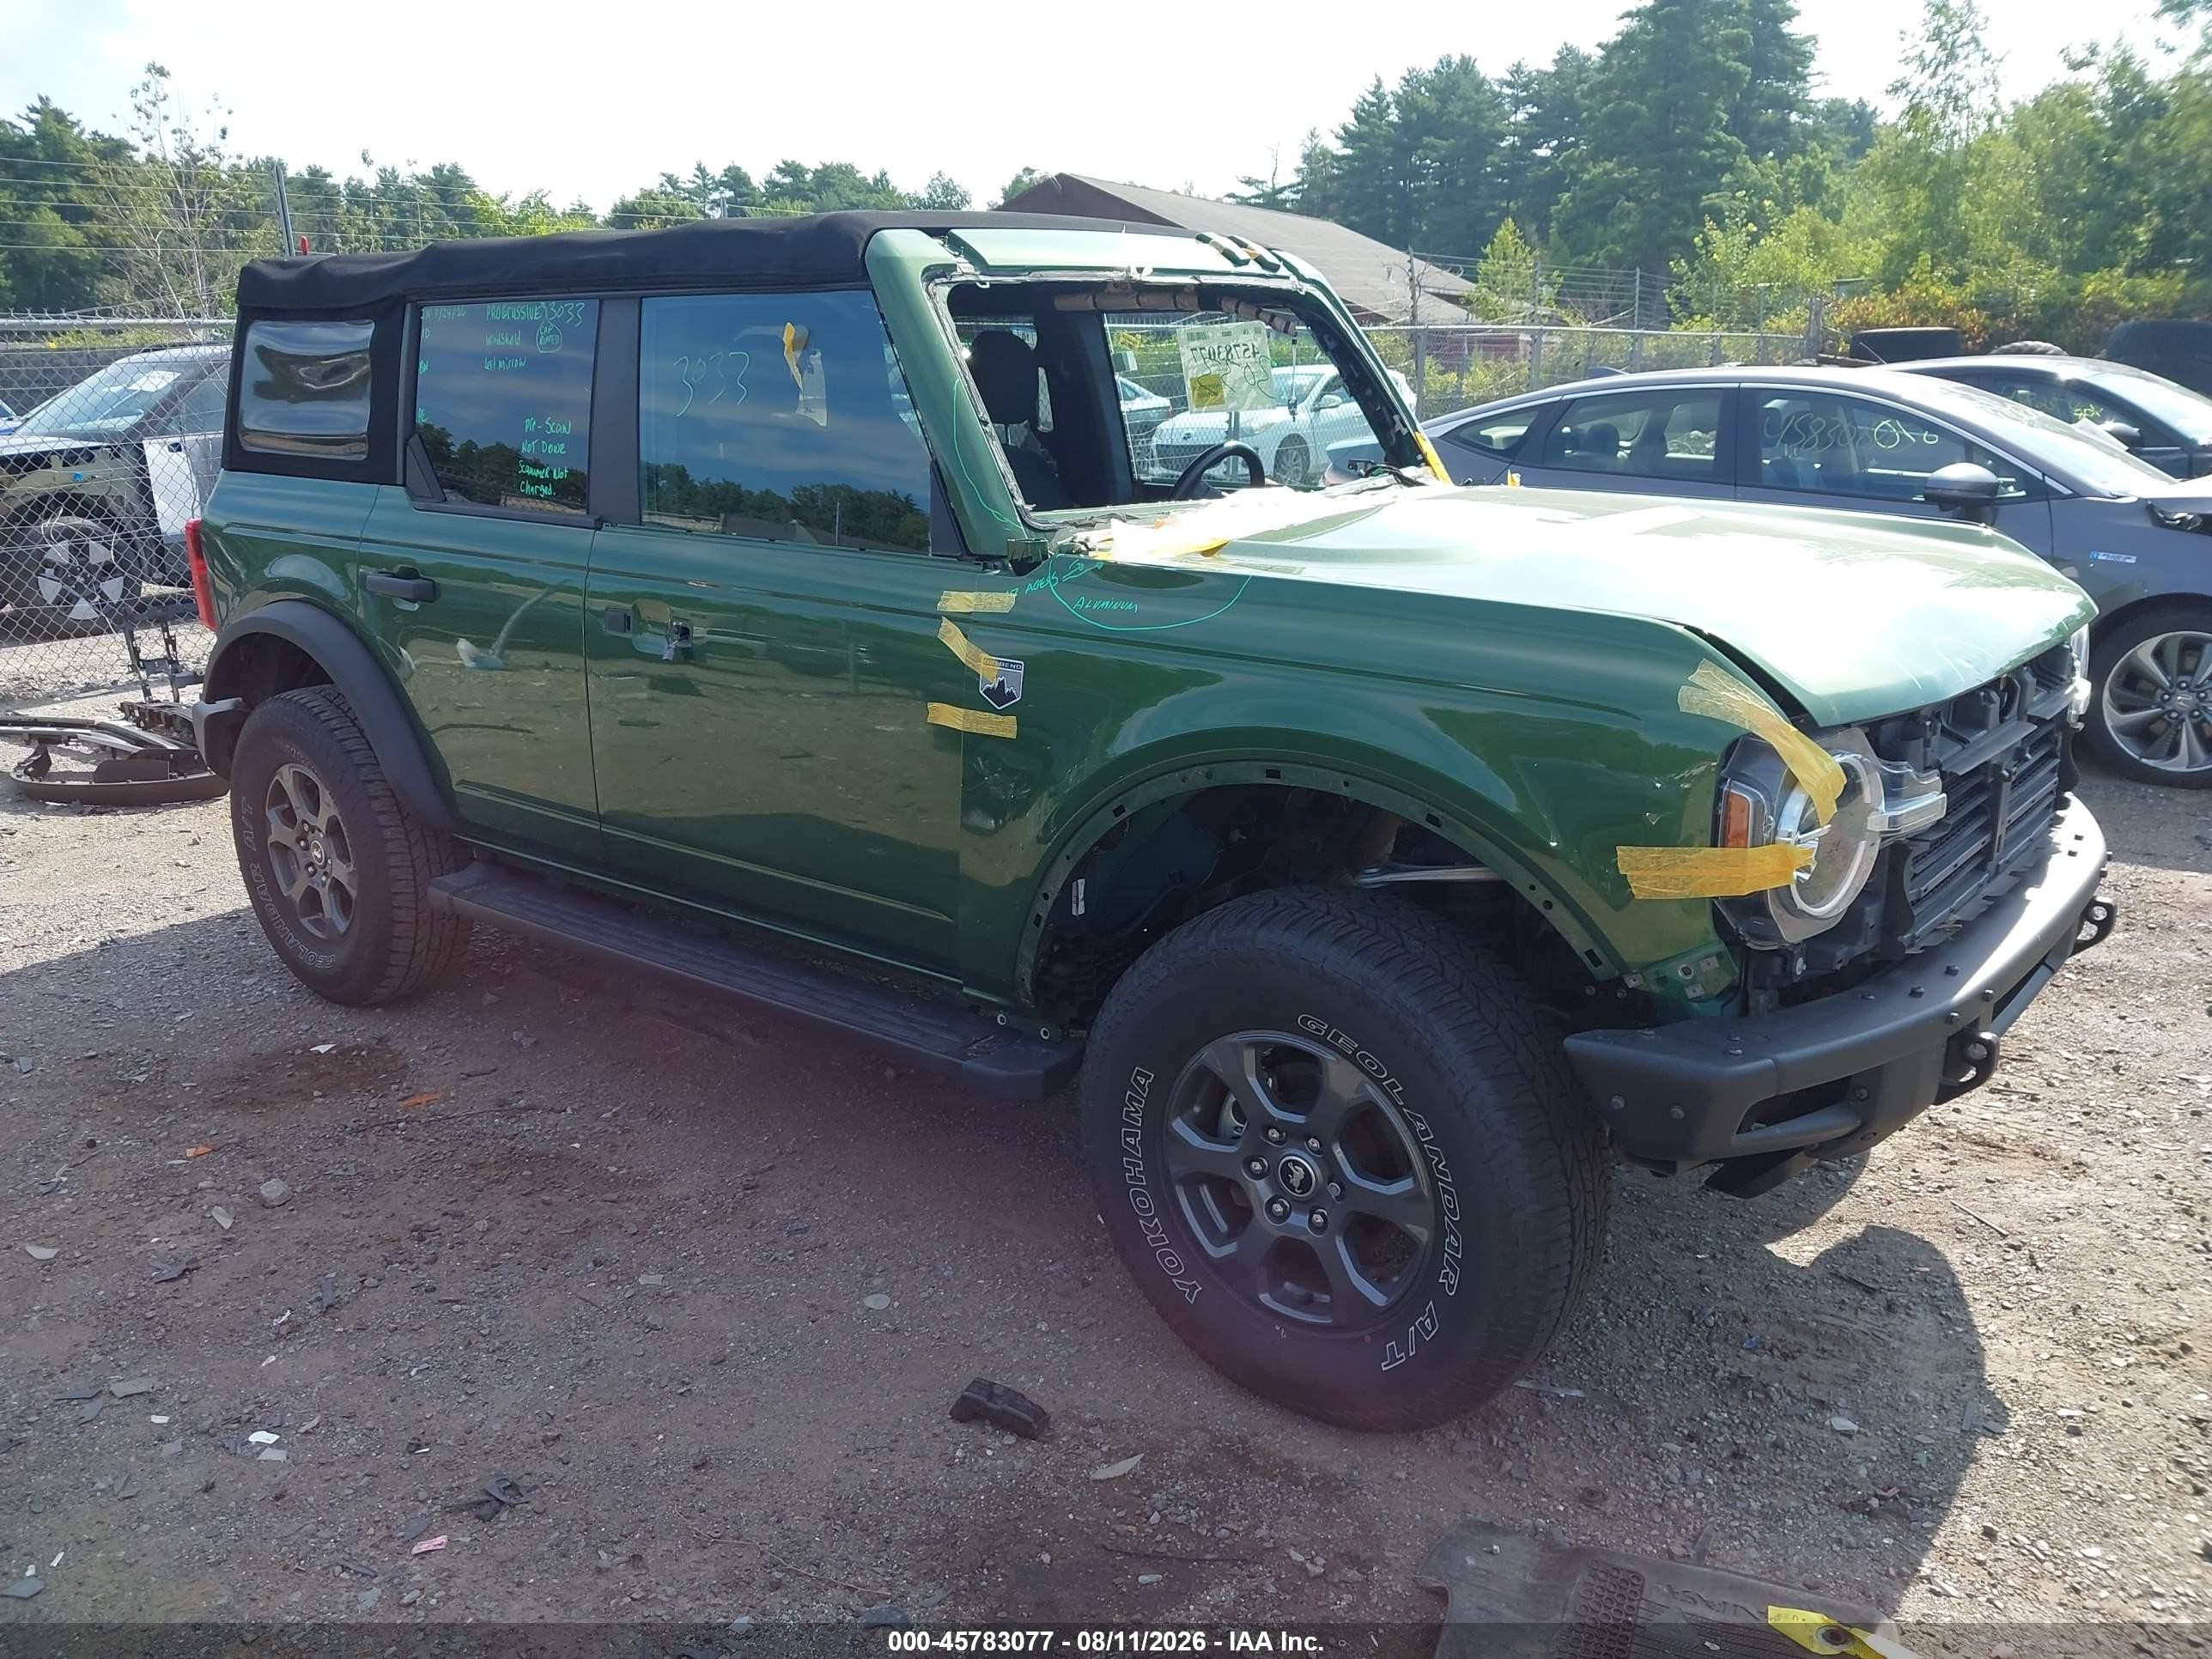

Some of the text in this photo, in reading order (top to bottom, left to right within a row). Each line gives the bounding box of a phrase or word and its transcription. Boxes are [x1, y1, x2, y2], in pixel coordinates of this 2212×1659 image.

[672, 351, 750, 417] 3033
[1121, 1066, 1204, 1304] YOKOHAMA
[1297, 1012, 1466, 1372] GEOLANDAR A/T
